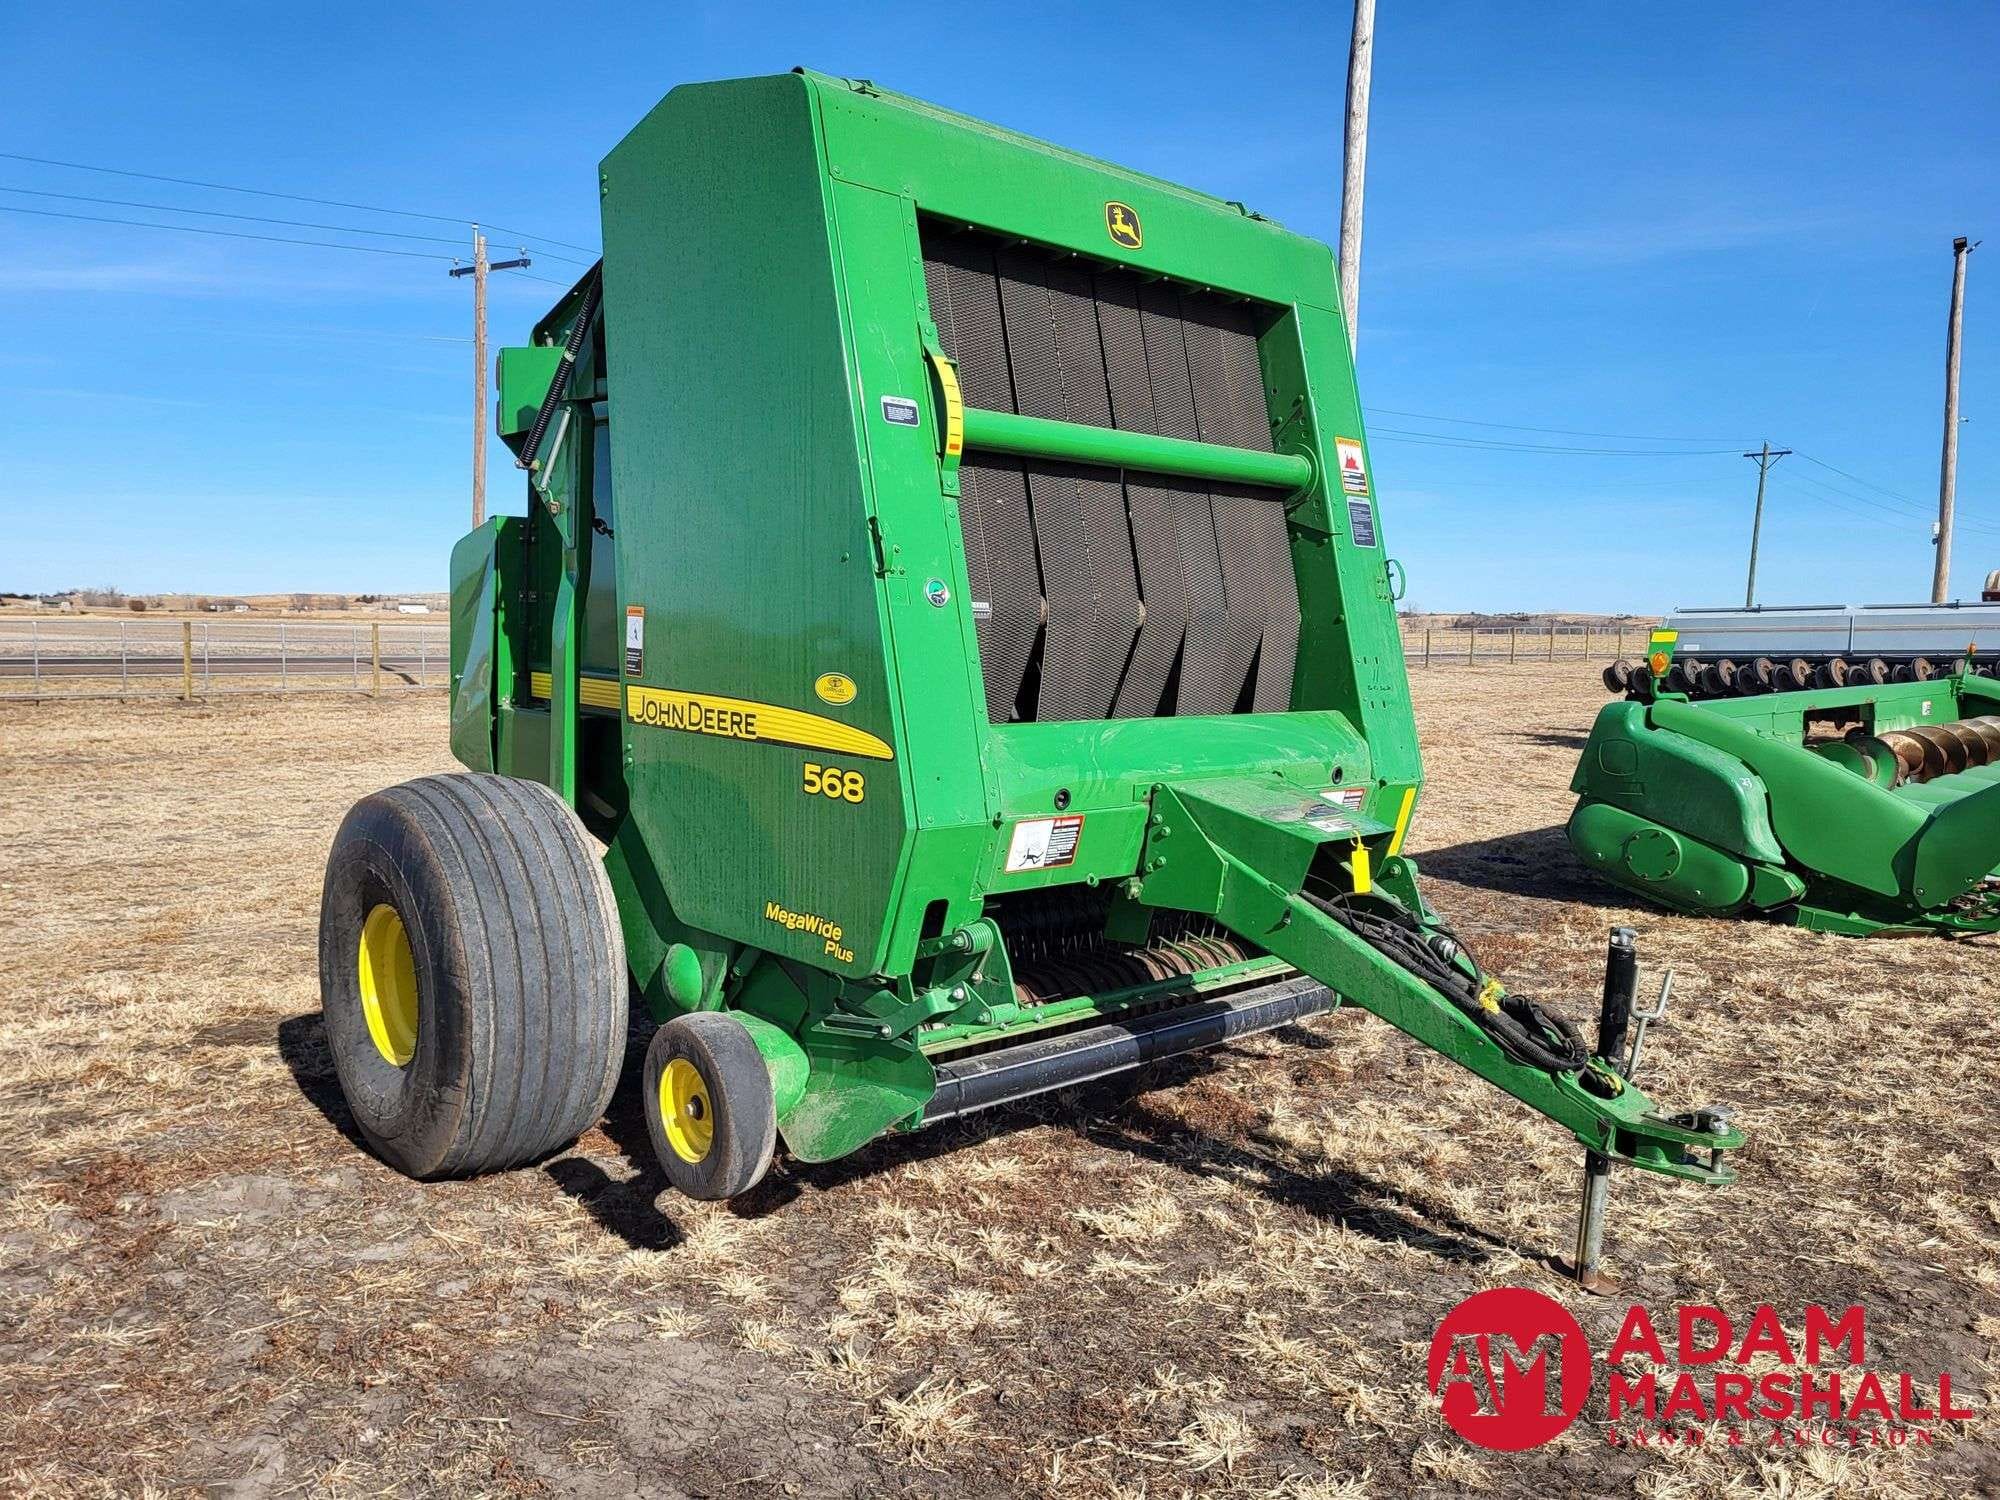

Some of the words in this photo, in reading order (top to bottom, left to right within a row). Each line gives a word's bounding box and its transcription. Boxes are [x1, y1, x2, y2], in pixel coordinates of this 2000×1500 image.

[636, 695, 685, 726] JOHN
[687, 700, 757, 736] DEERE
[803, 762, 865, 804] 568
[764, 901, 843, 942] MegaWide
[823, 939, 855, 963] Plus
